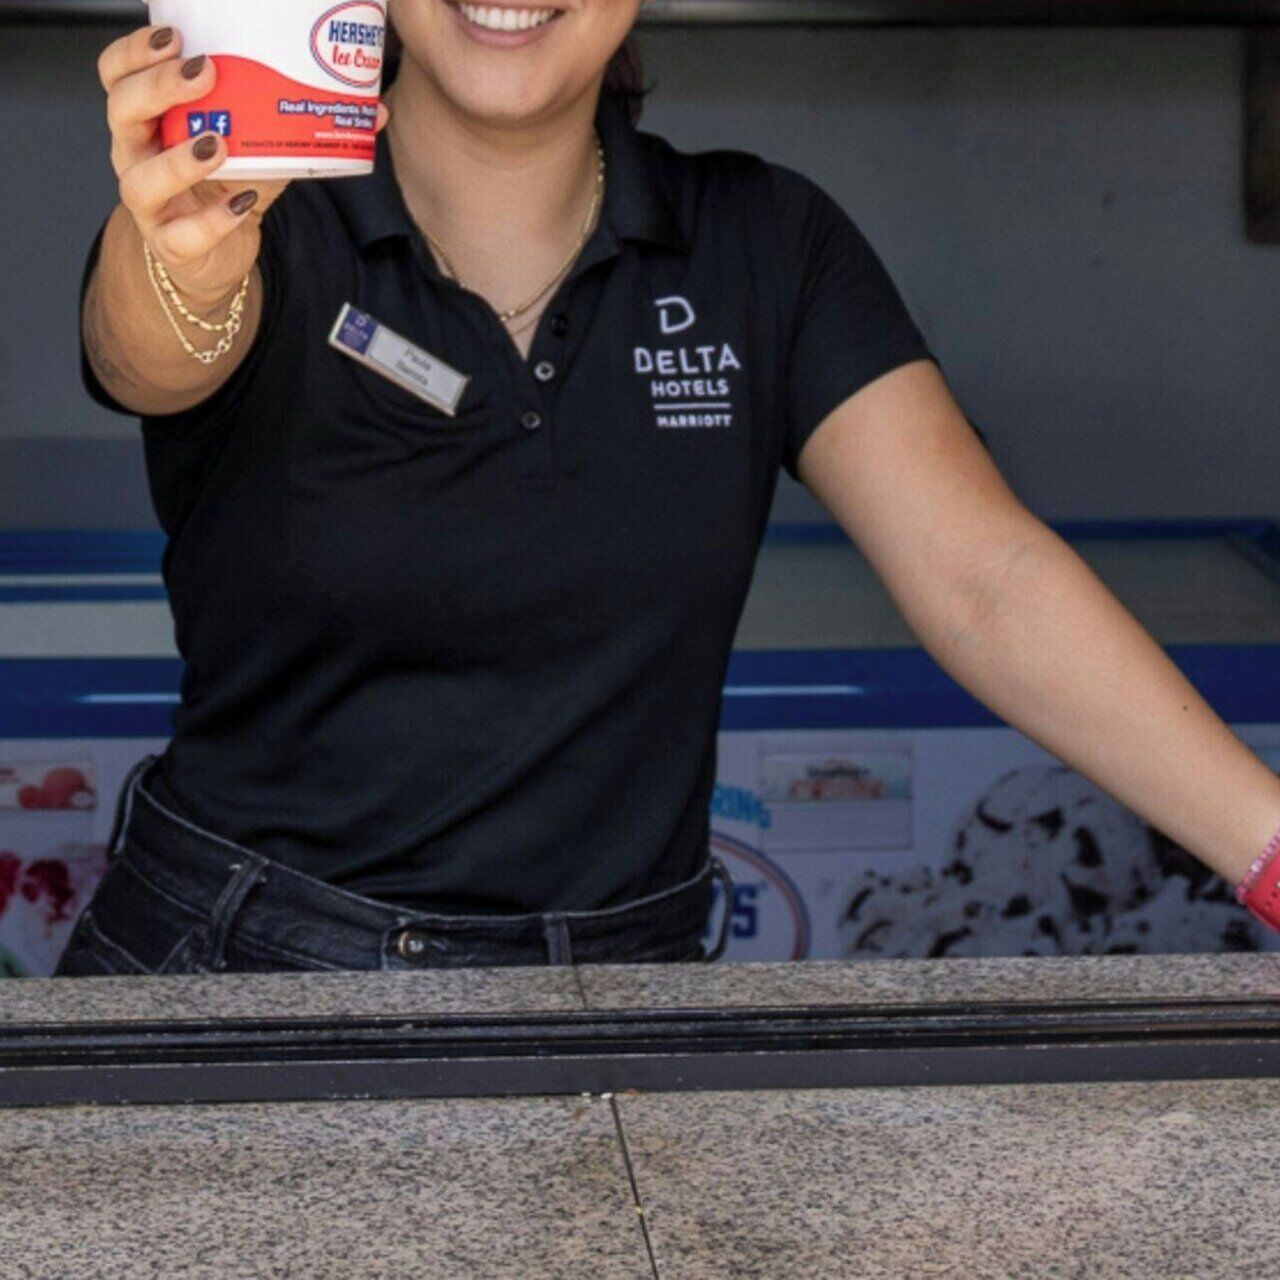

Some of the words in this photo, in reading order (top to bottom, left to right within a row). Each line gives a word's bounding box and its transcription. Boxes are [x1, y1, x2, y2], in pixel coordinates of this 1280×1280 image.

[633, 342, 742, 375] DELTA
[651, 378, 729, 397] HOTELS
[656, 414, 733, 428] MARRIOTT
